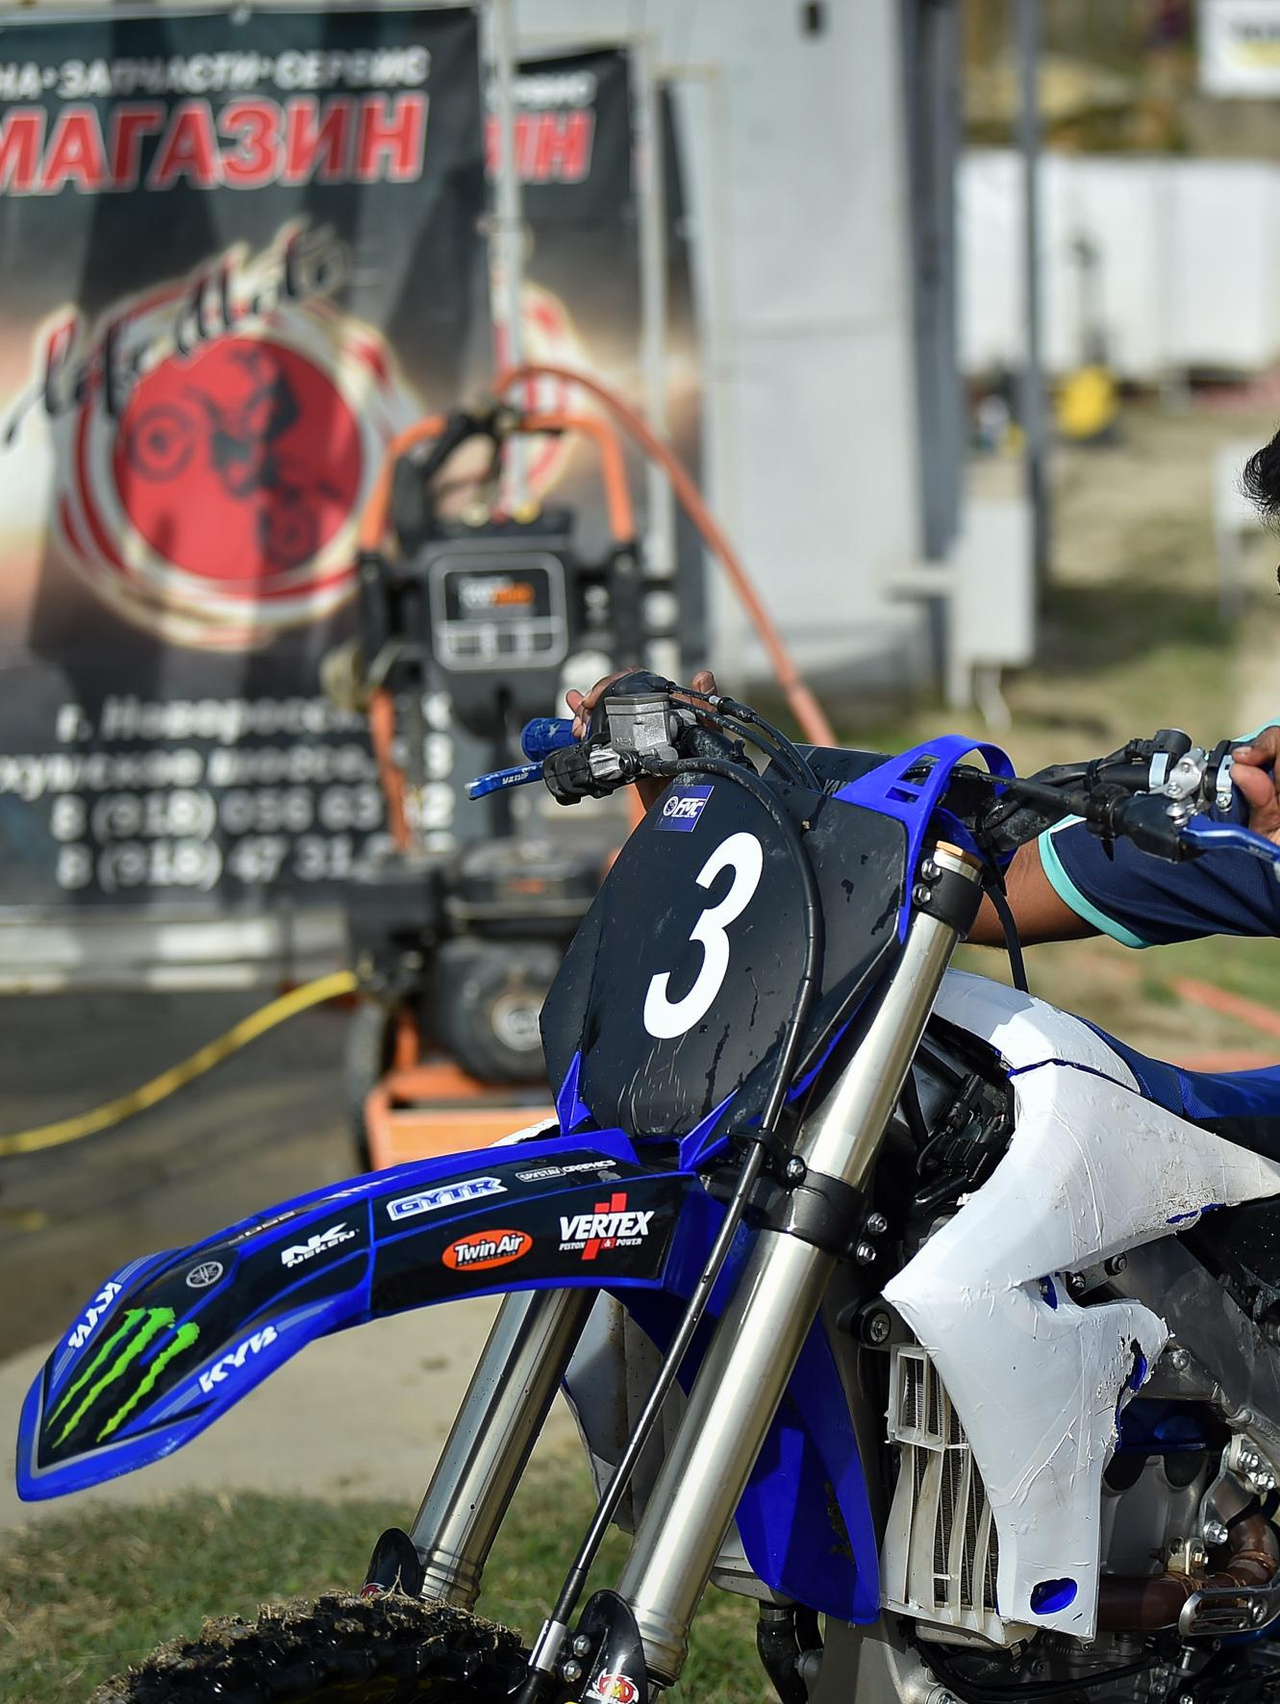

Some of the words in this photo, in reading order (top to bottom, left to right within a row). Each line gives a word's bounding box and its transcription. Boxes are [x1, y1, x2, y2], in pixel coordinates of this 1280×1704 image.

[643, 832, 764, 1039] 3
[395, 1178, 498, 1216] GYTR
[560, 1210, 655, 1241] VERTEX
[454, 1240, 497, 1262] Twin
[496, 1234, 524, 1253] Air
[559, 1242, 586, 1251] PISTON
[615, 1238, 642, 1246] POWER
[199, 1325, 278, 1393] KYB
